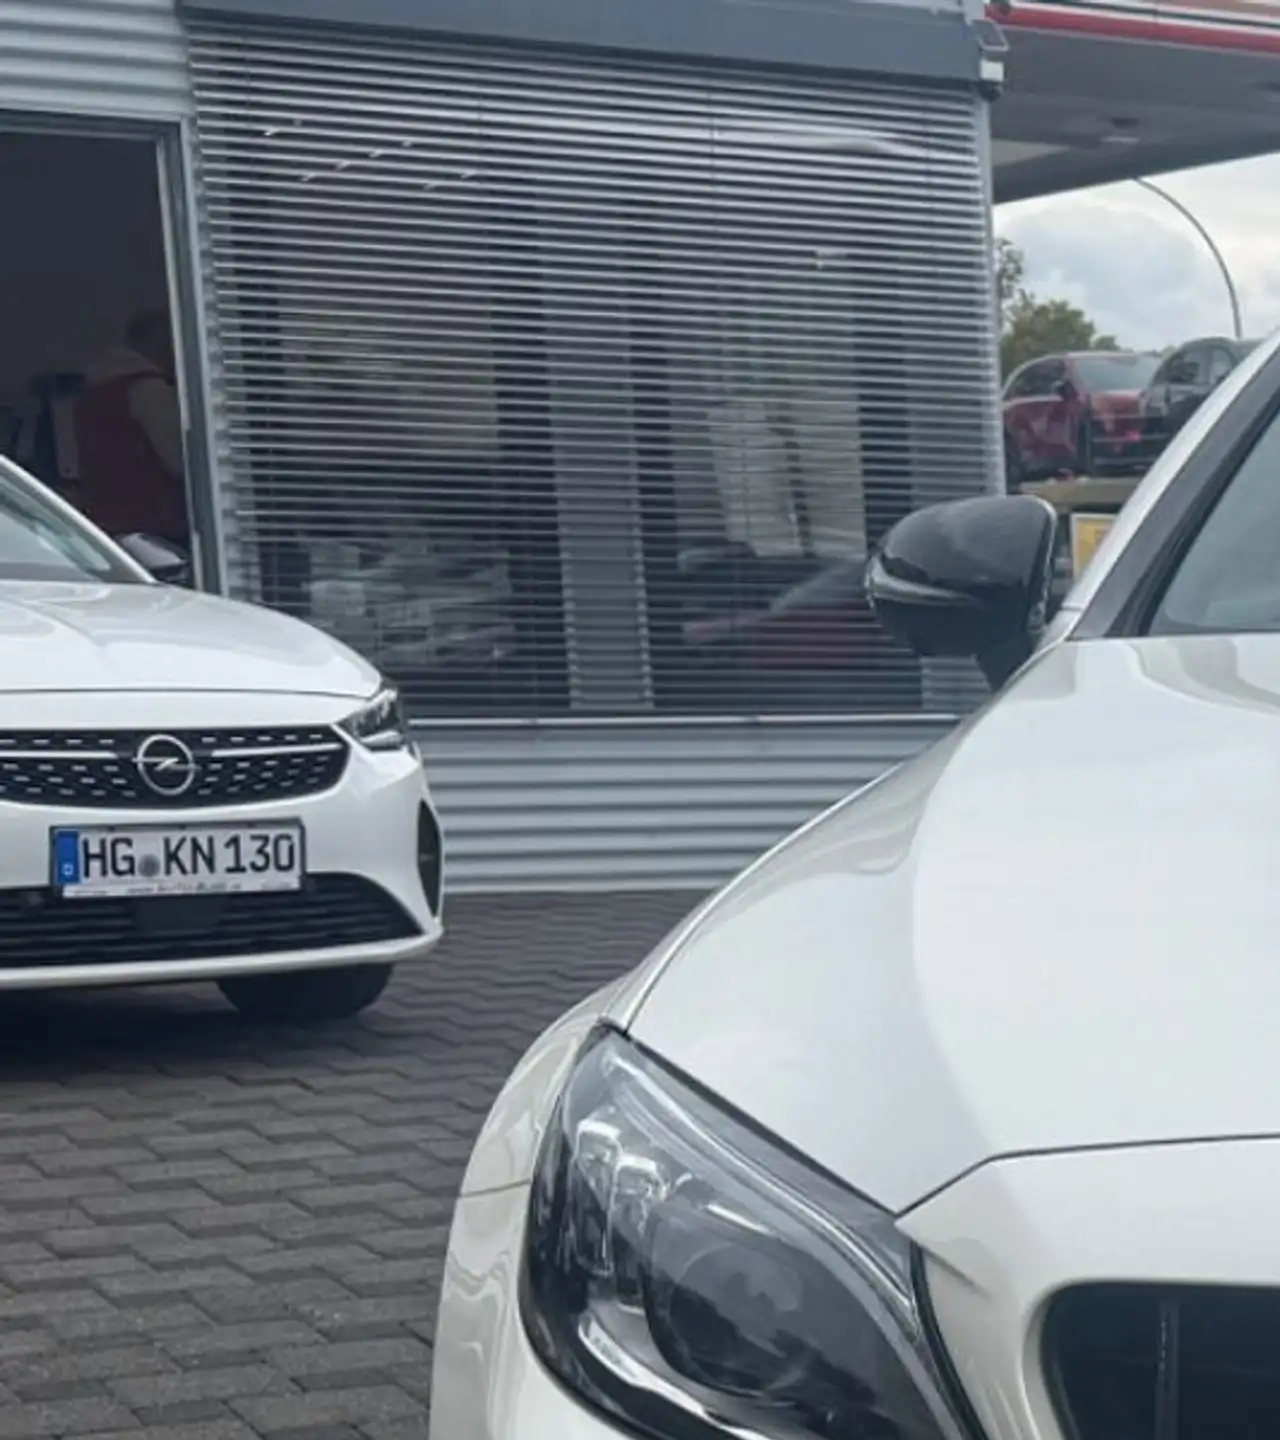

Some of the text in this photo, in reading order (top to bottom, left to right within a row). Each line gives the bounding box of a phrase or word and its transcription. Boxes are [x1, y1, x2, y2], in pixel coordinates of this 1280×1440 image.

[83, 833, 295, 877] HG KN 130
